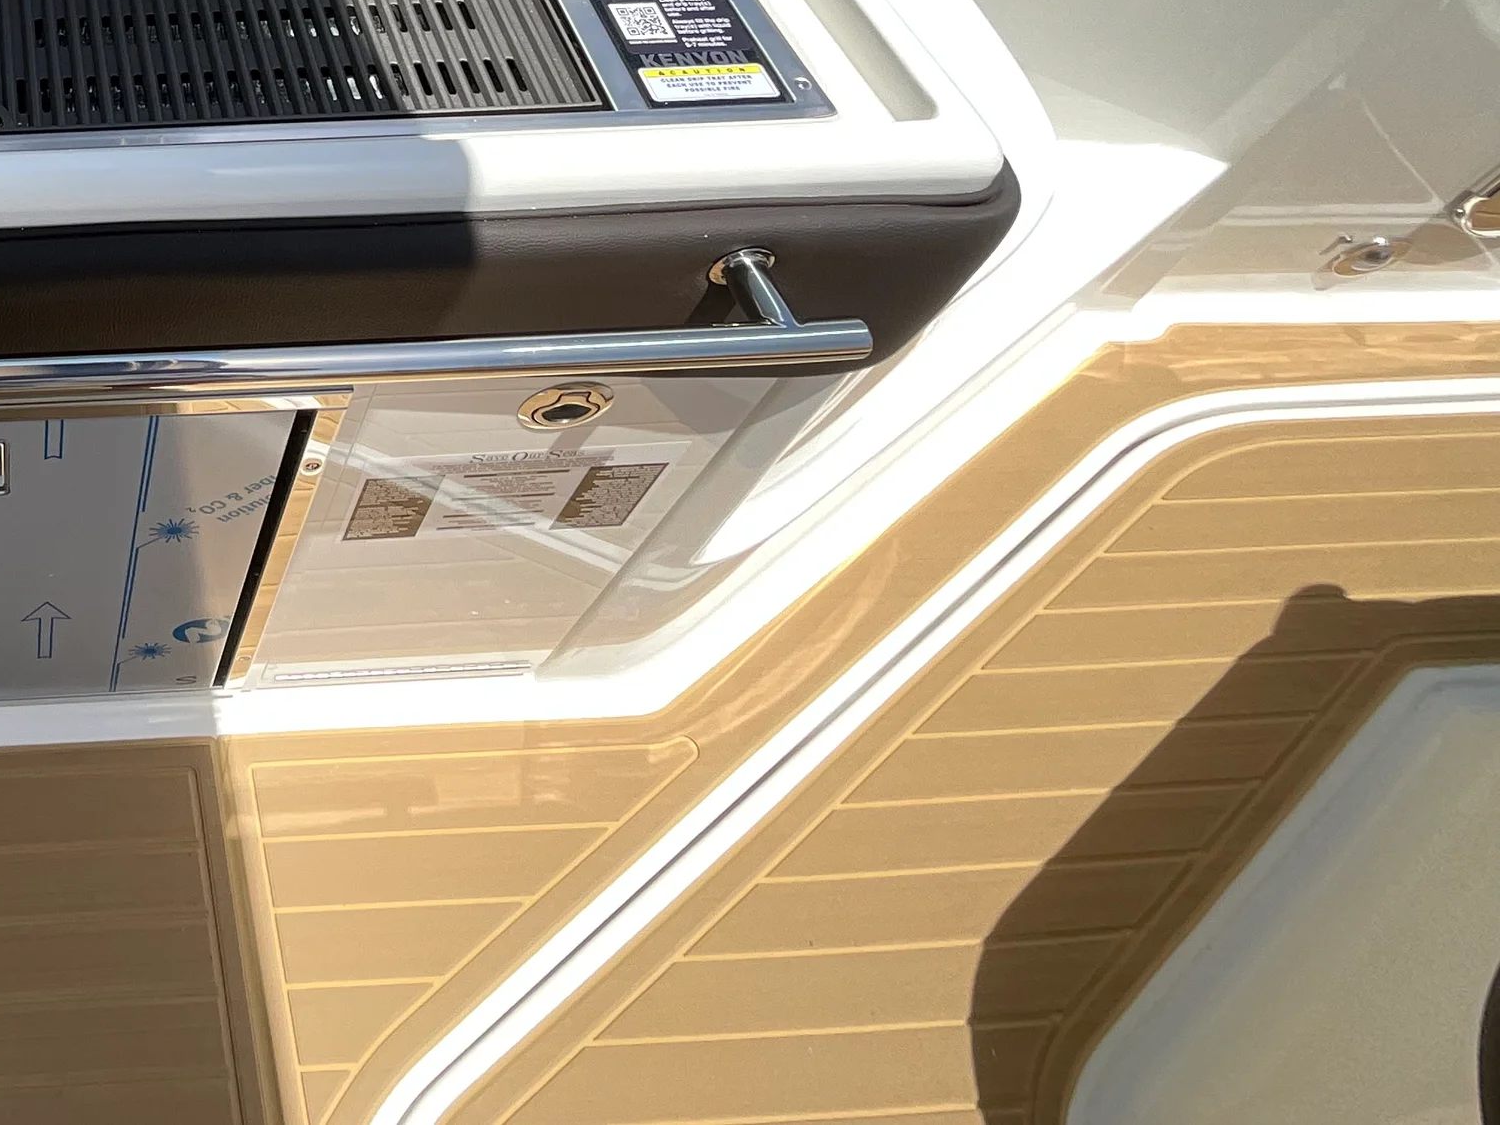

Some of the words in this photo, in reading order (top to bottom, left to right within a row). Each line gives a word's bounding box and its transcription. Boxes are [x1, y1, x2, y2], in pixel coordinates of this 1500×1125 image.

[640, 50, 749, 68] KENYON
[669, 67, 746, 75] CAUTION
[470, 453, 508, 463] Save
[511, 451, 545, 462] Our
[546, 449, 586, 459] Seas
